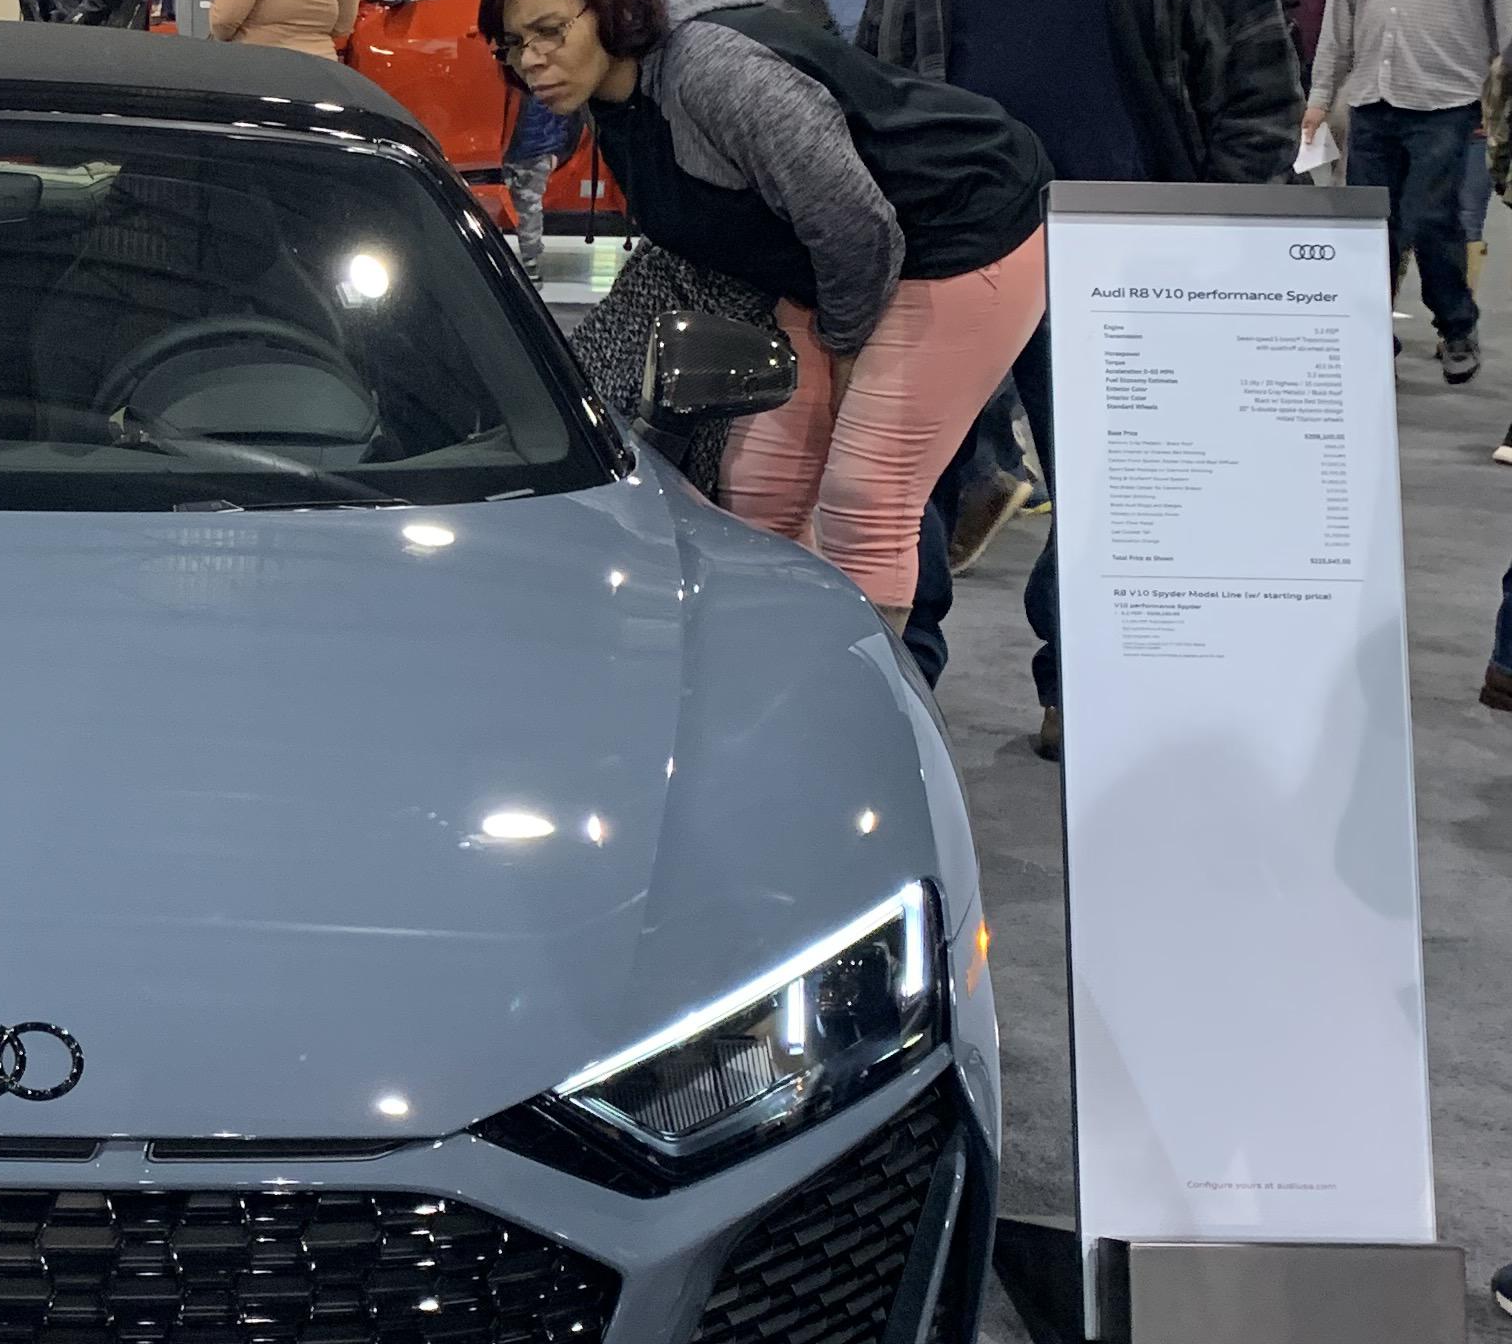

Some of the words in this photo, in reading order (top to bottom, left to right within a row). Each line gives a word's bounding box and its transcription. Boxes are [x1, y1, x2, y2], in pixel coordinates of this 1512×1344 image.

[1091, 287, 1126, 298] Audi
[1129, 287, 1149, 299] R8
[1152, 288, 1184, 299] V10
[1188, 289, 1283, 302] performance
[1286, 290, 1338, 304] Spyder
[1152, 590, 1186, 598] Spyder
